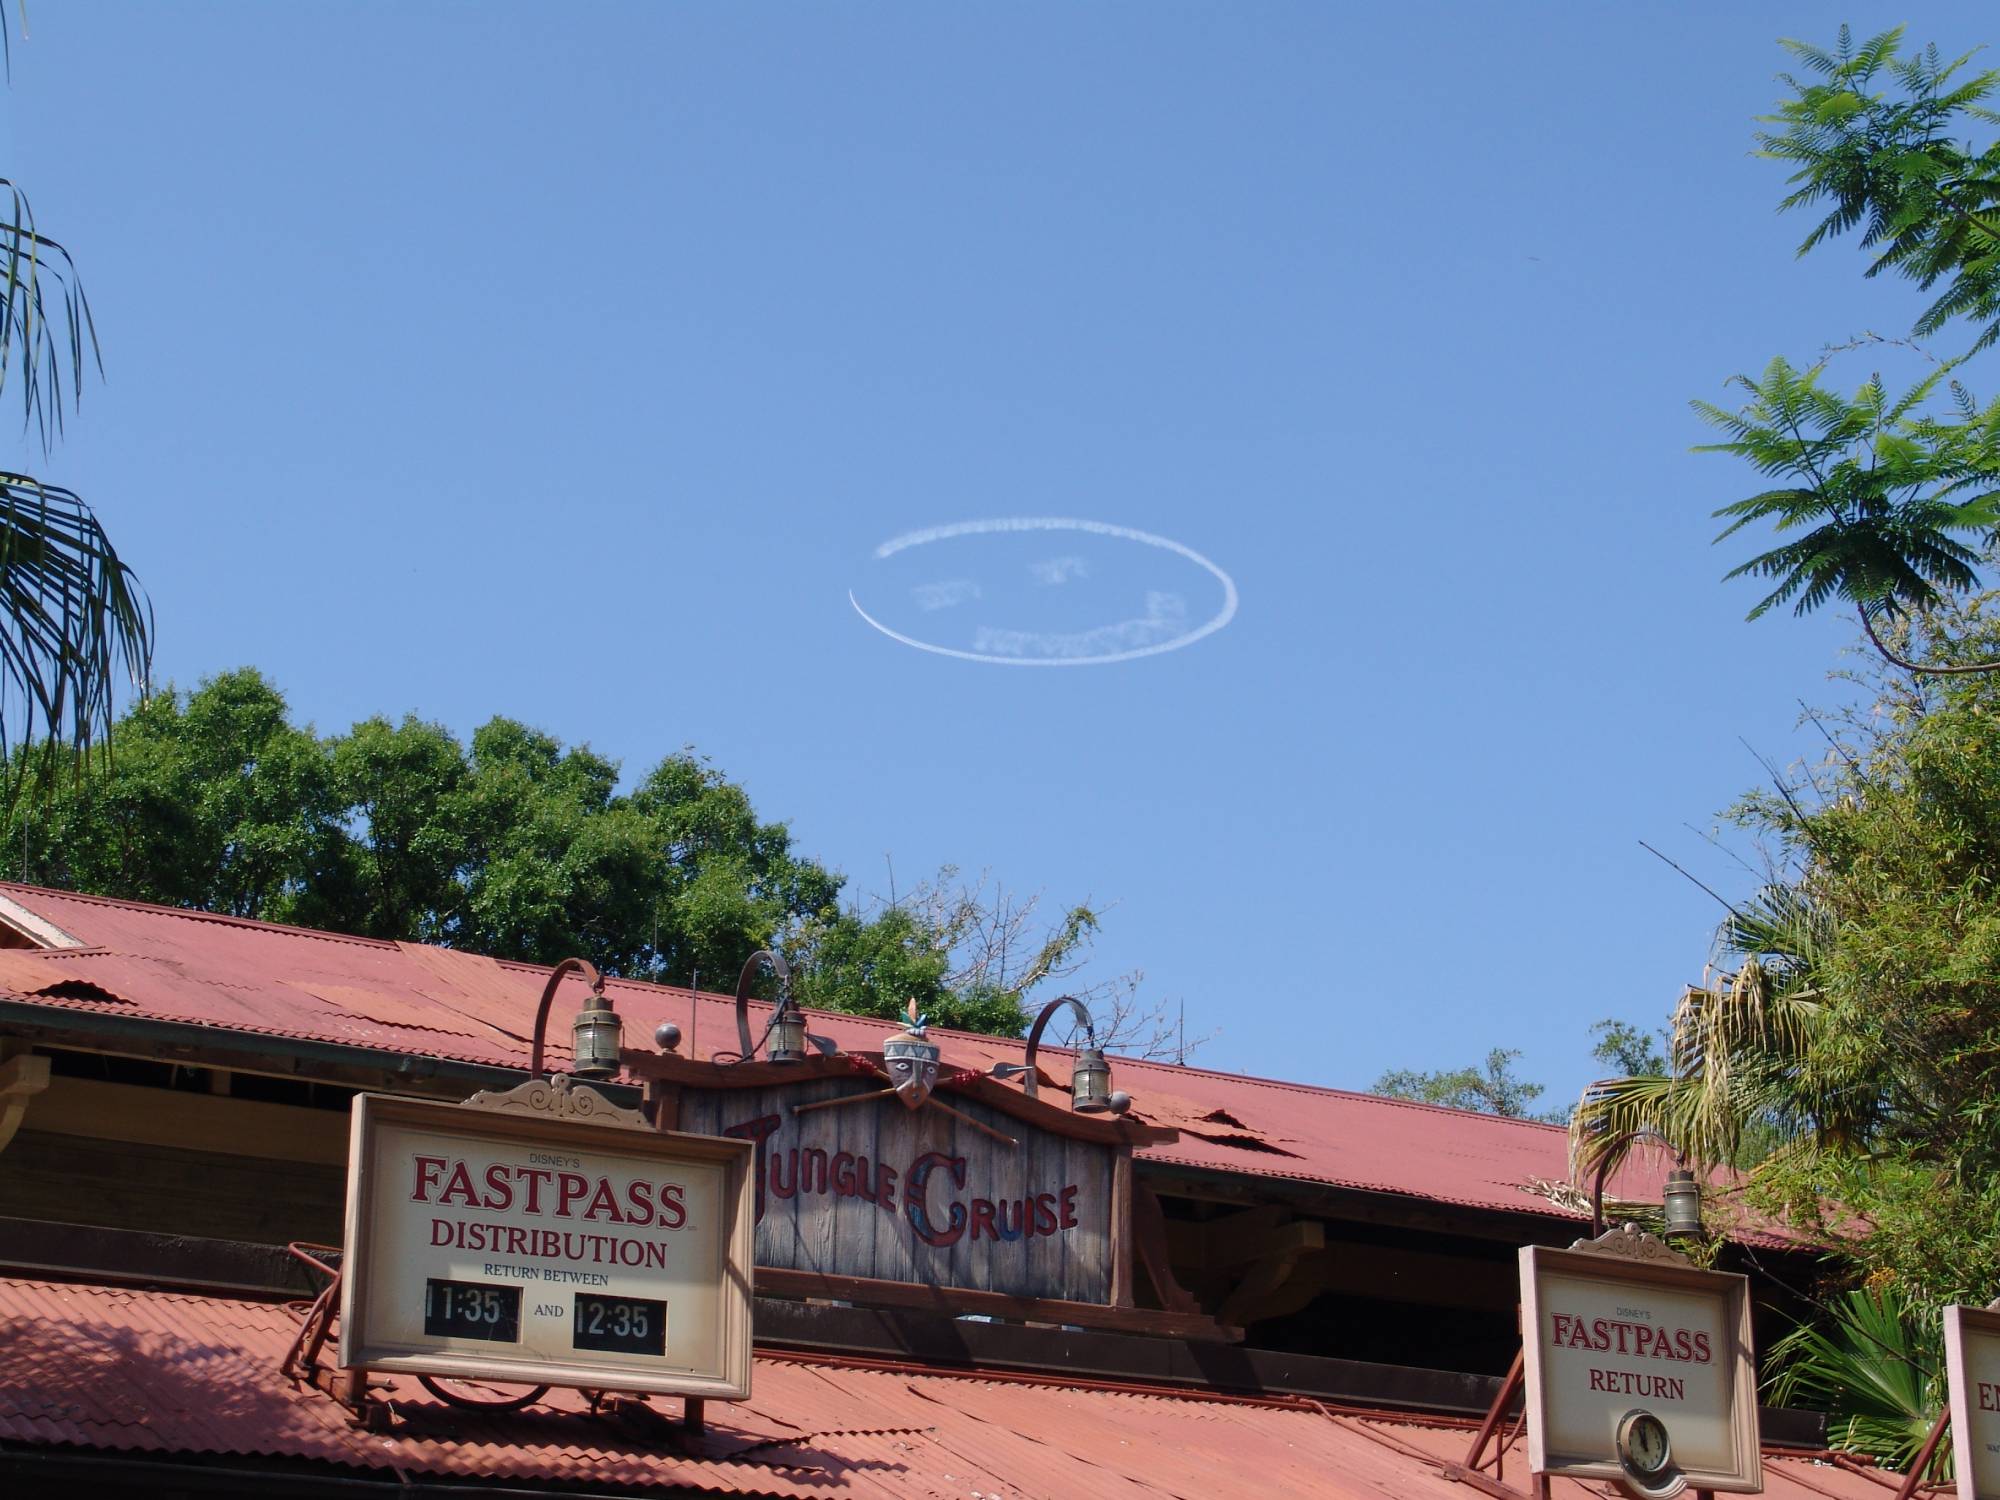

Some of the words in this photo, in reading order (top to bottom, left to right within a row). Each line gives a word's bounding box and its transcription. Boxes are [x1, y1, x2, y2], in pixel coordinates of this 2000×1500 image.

[529, 1153, 580, 1168] DISNEY'S
[410, 1154, 688, 1231] FASTPASS
[903, 1152, 1078, 1248] CRUISE
[430, 1219, 667, 1269] DISTRIBUTION
[484, 1263, 539, 1280] RETURN
[544, 1269, 608, 1286] BETWEEN
[534, 1304, 564, 1318] AND
[575, 1301, 649, 1338] 12:35
[1551, 1312, 1713, 1364] FASTPASS
[1589, 1368, 1684, 1401] RETURN
